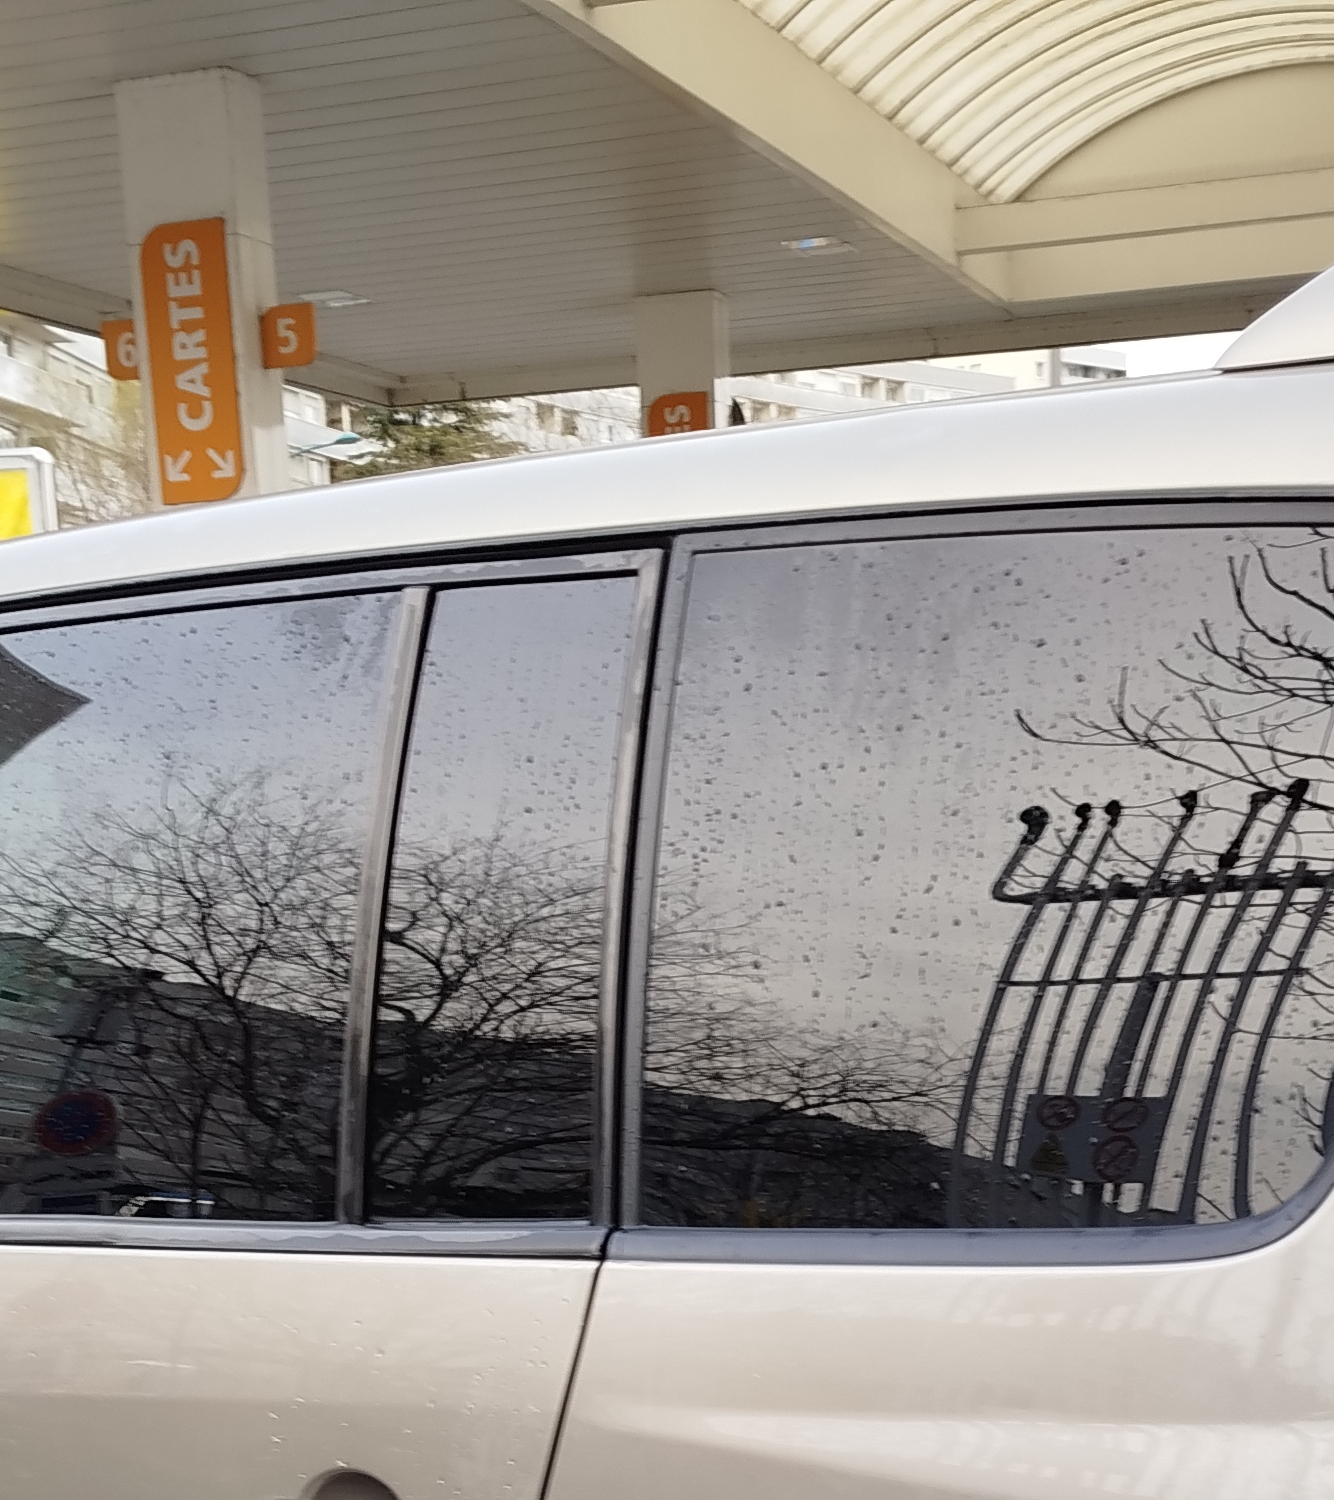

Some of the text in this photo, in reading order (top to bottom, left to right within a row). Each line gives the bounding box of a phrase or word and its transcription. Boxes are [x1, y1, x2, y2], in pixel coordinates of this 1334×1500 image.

[118, 332, 137, 367] 6
[163, 239, 214, 431] CARTES
[276, 317, 299, 354] 5
